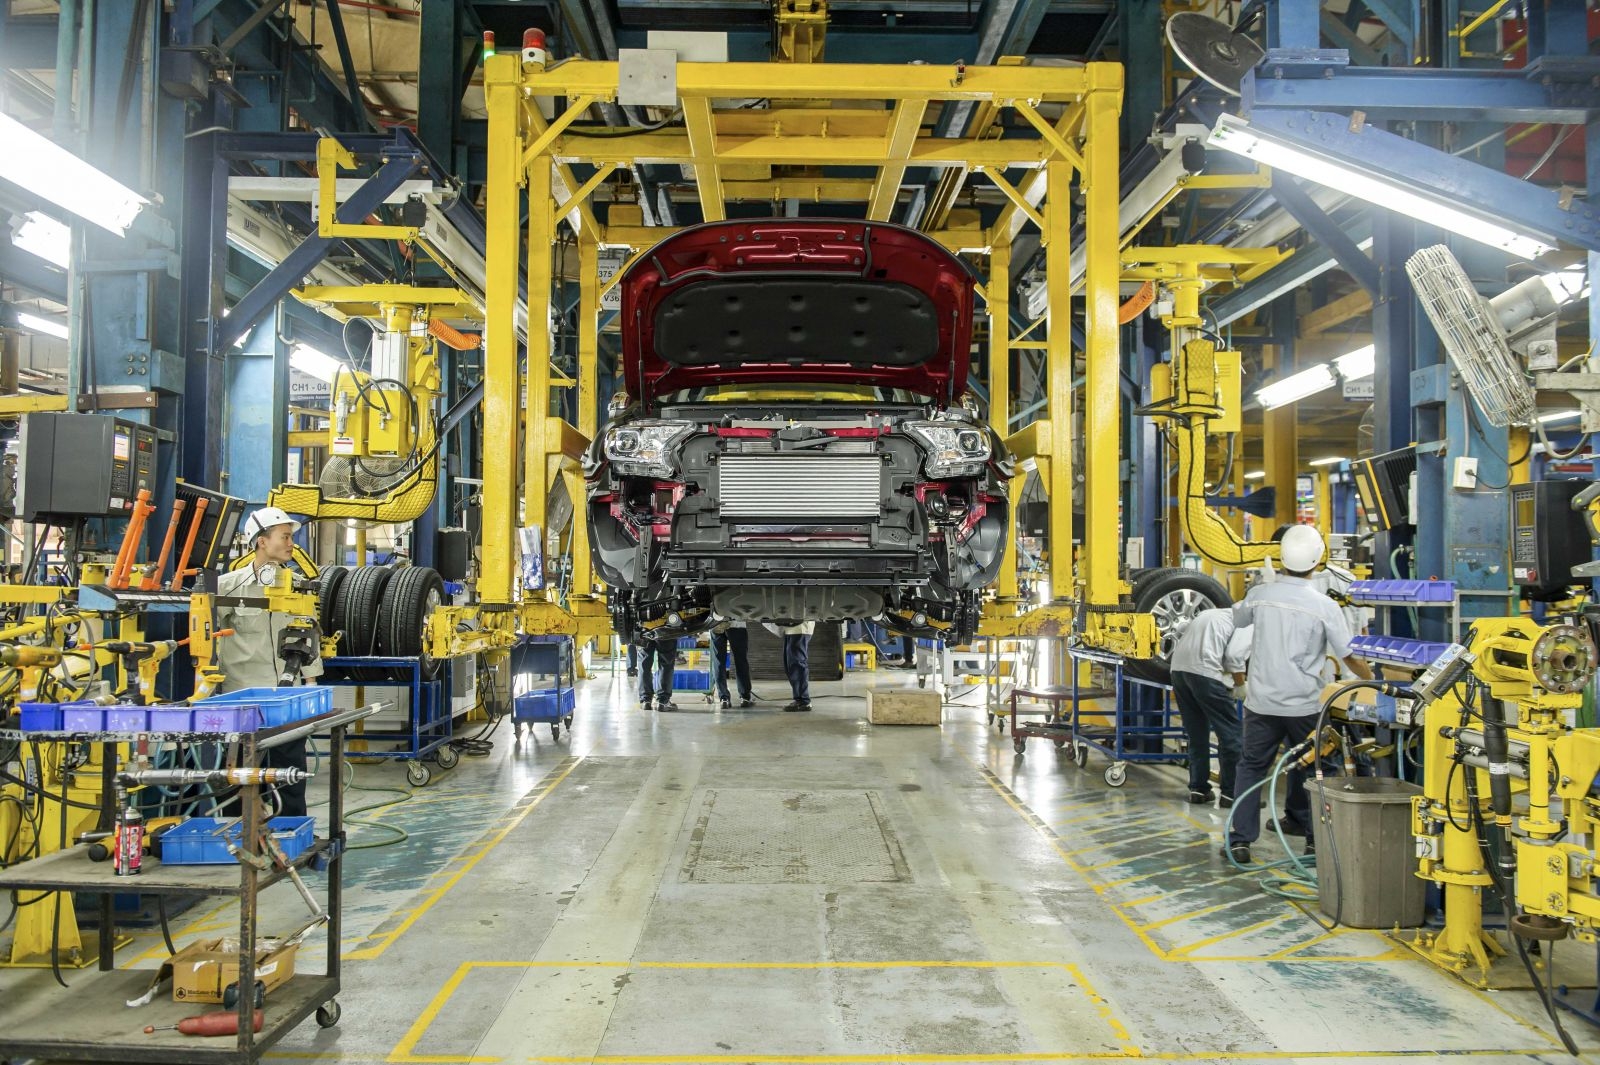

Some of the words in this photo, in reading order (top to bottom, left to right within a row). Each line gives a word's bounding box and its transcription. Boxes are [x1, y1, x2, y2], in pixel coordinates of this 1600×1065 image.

[598, 270, 613, 278] 375
[291, 383, 309, 391] CH1
[317, 383, 327, 391] 04
[1345, 386, 1361, 394] CH1
